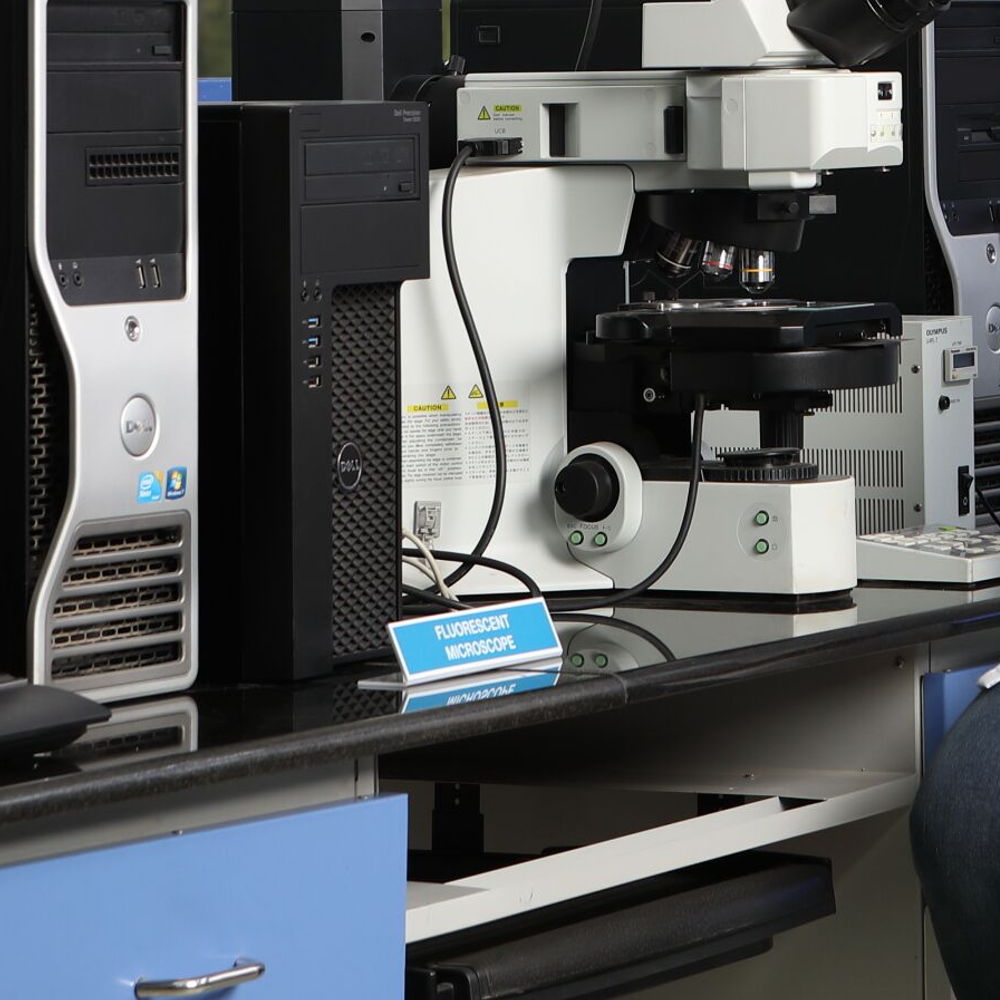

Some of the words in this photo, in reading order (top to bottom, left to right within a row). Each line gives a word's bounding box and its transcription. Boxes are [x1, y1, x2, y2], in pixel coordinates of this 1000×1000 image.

[495, 104, 520, 112] CAUTION
[413, 404, 442, 412] CAUTION
[434, 613, 511, 641] FLUORESCENT
[444, 634, 517, 661] MICROSCOPE
